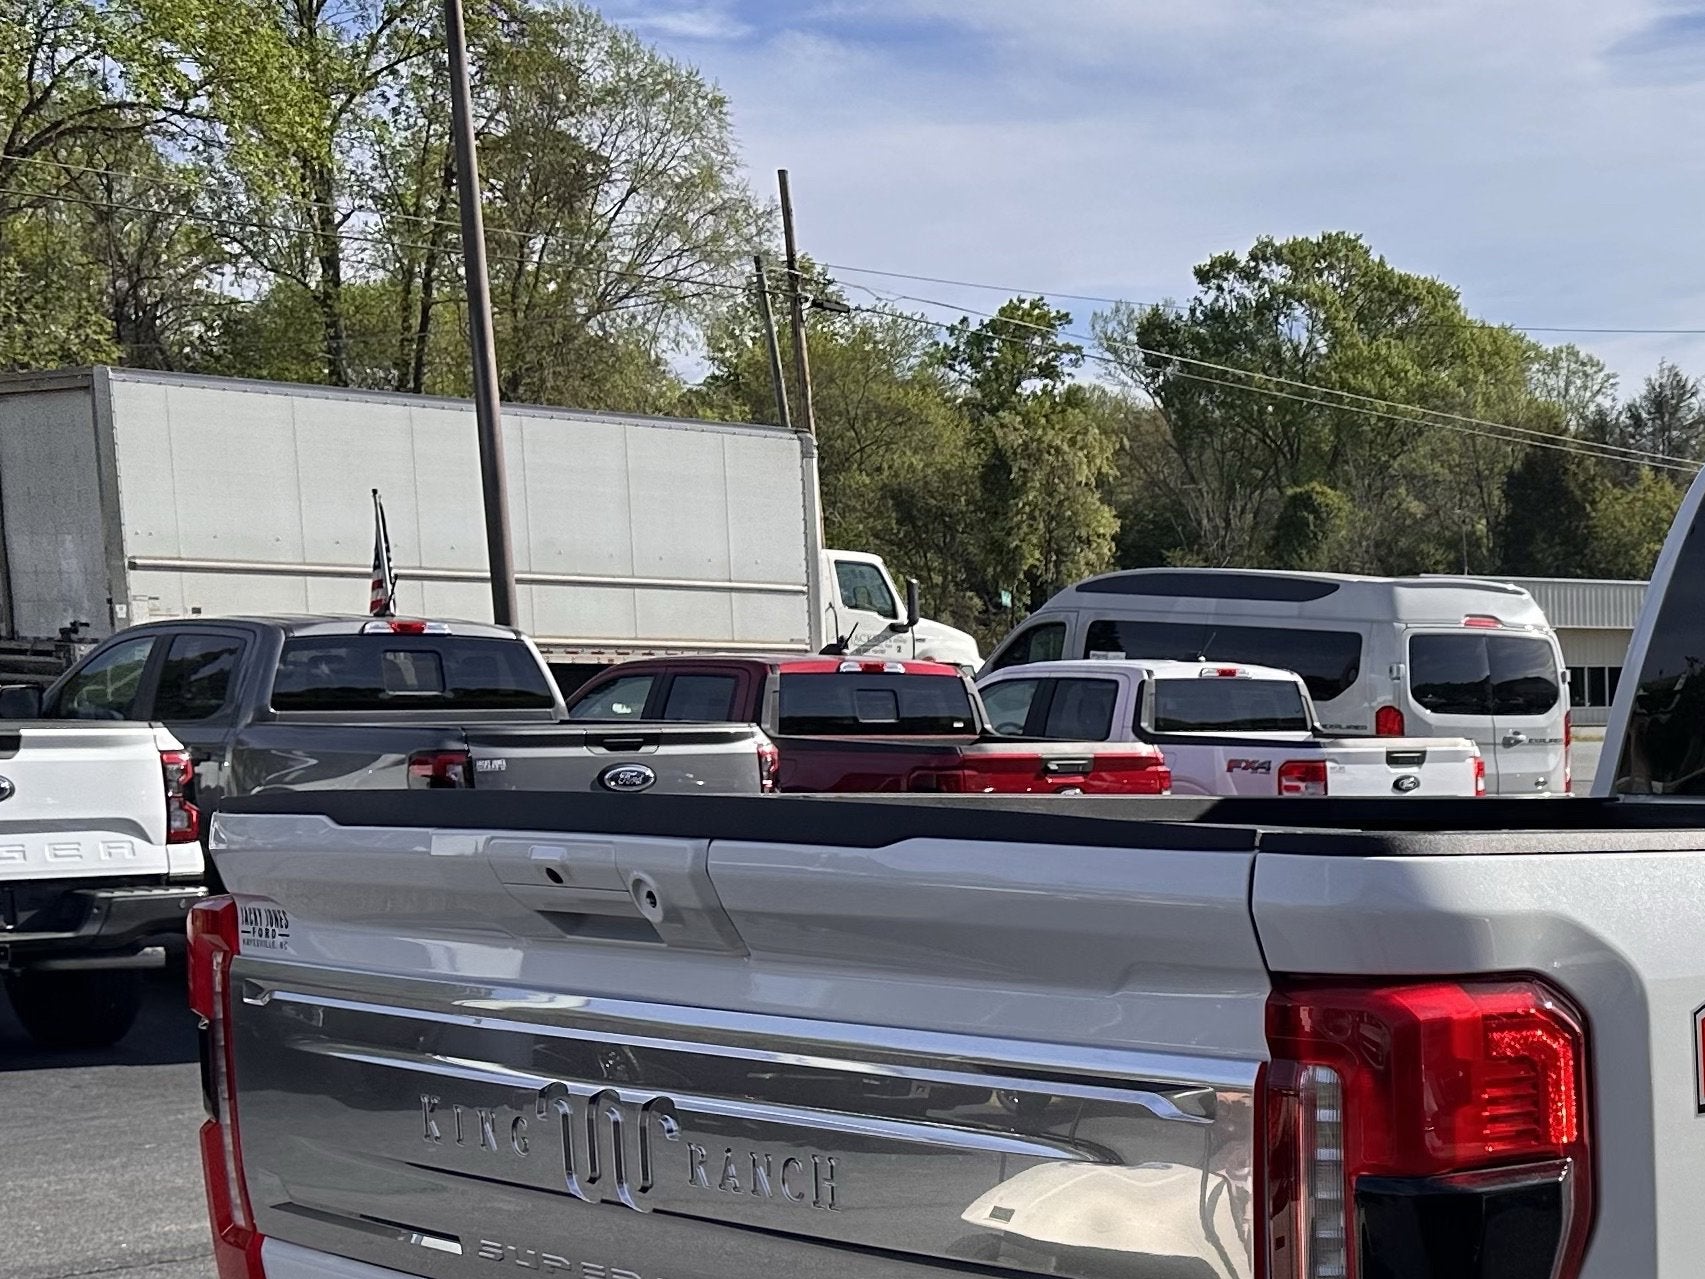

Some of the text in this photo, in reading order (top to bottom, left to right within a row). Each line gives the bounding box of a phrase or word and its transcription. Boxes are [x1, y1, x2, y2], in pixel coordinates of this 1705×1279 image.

[1226, 759, 1272, 773] FX4
[264, 907, 289, 930] JONES
[252, 926, 277, 940] FORD
[419, 1093, 840, 1213] KING RANCH
